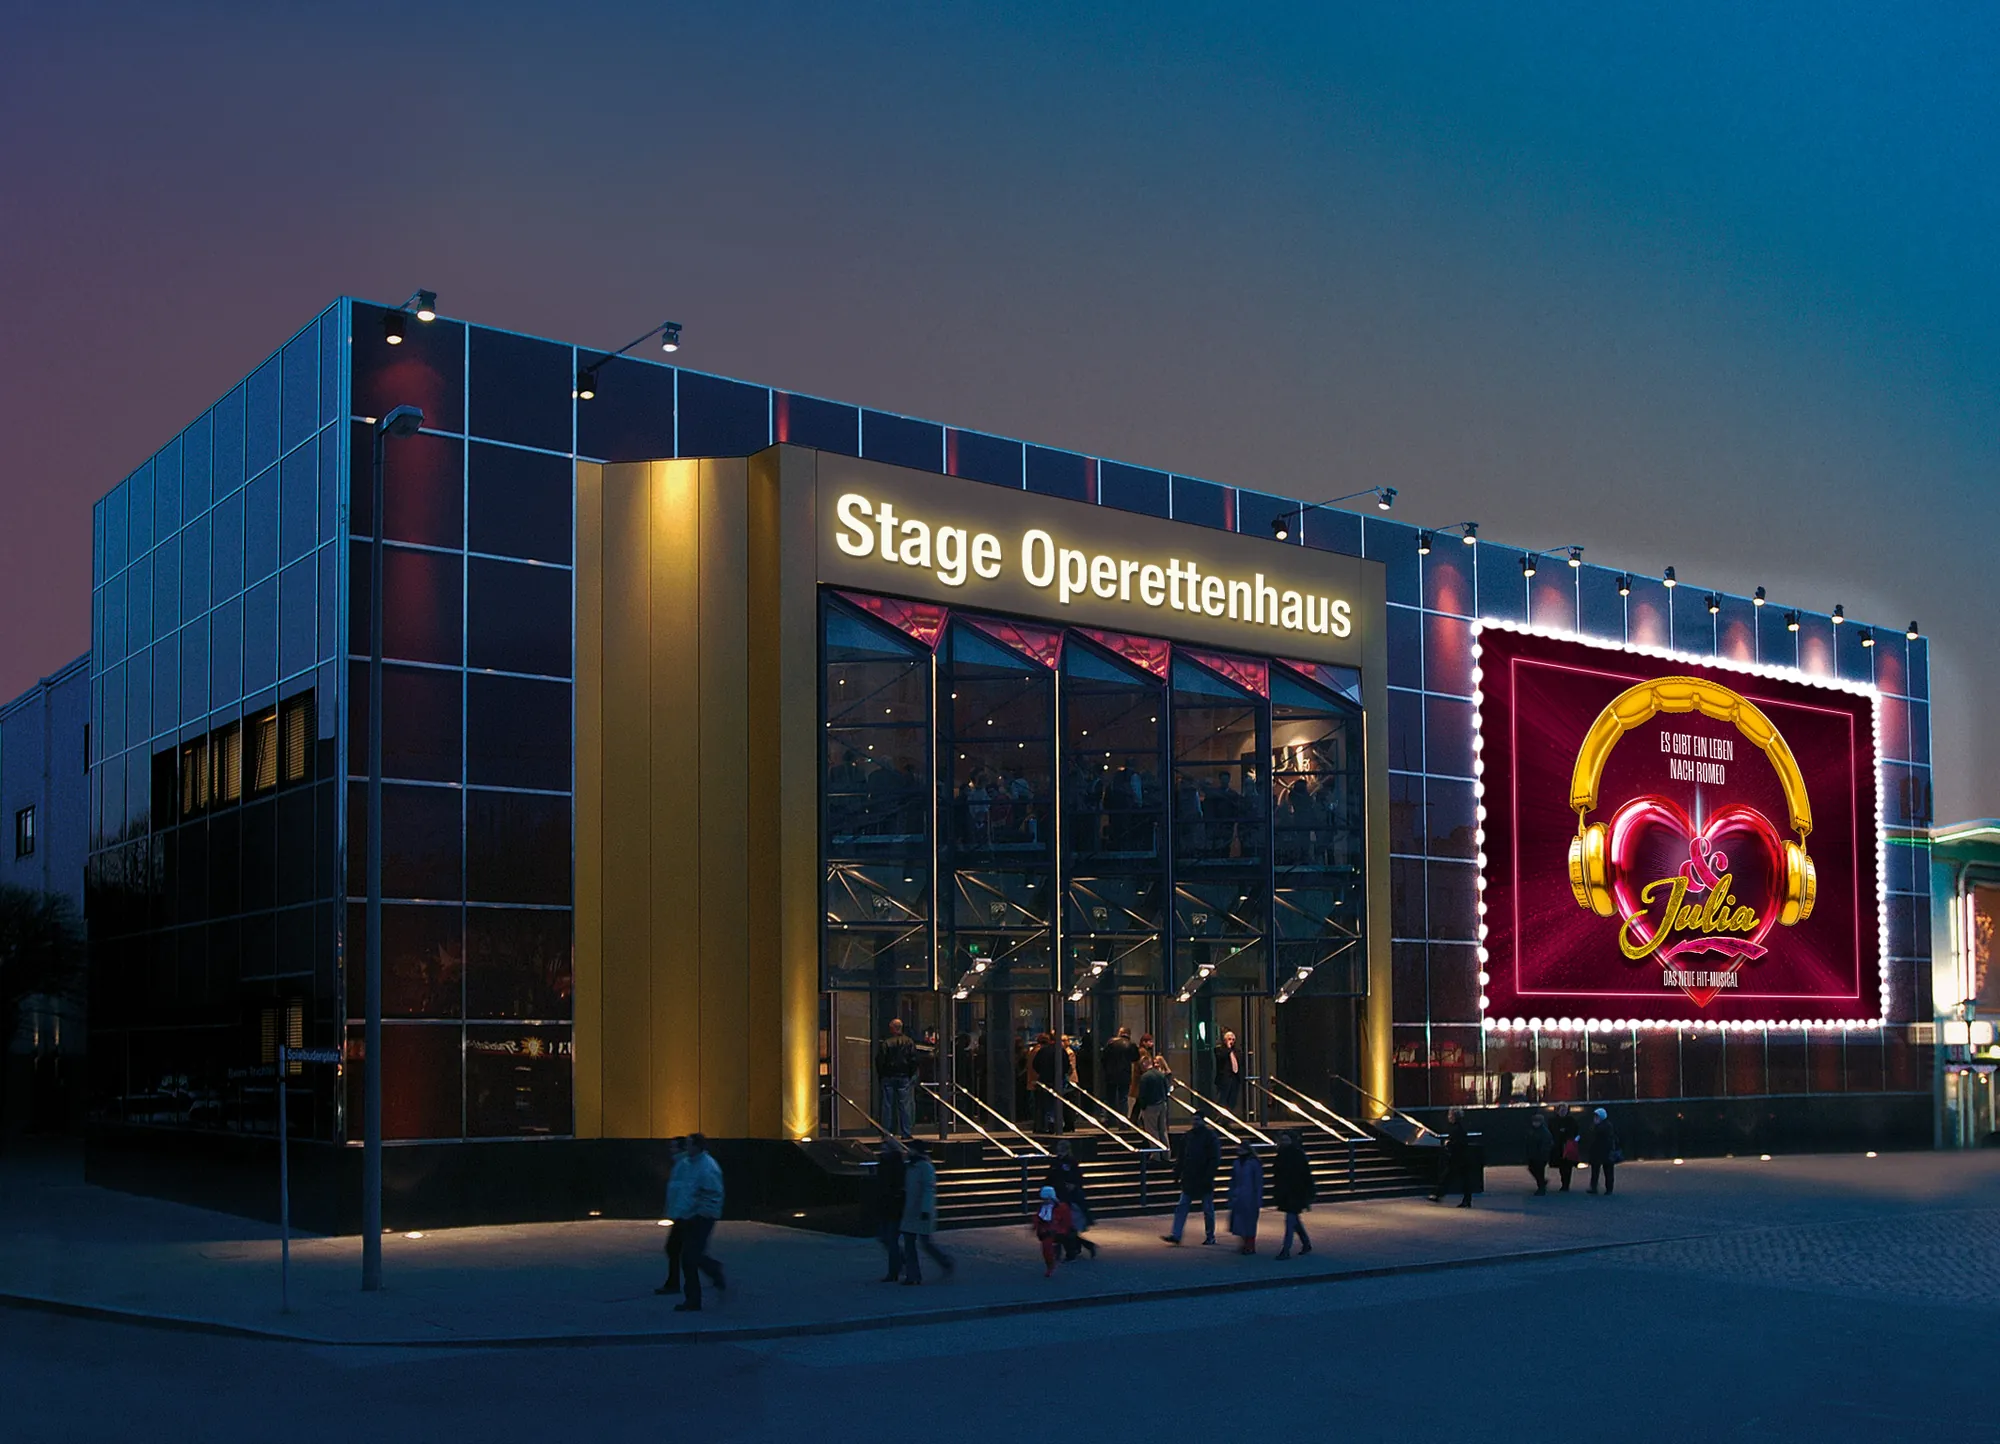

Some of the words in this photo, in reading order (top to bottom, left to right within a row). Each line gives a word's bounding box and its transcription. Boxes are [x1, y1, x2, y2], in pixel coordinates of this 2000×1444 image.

[835, 492, 1002, 587] Stage
[1021, 529, 1352, 639] Operettenhaus
[1660, 731, 1671, 753] ES
[1672, 732, 1692, 756] GIBT
[1693, 735, 1708, 758] EIN
[1709, 737, 1733, 761] LEBEN
[1670, 758, 1695, 782] NACH
[1696, 761, 1726, 786] ROMEO
[1679, 836, 1728, 893] &
[1619, 873, 1760, 960] Julia
[1663, 970, 1678, 987] DAS
[1678, 971, 1696, 987] NEUE
[1696, 971, 1739, 988] HIT-MUSICAL
[287, 1048, 339, 1063] Spielbudenplatz
